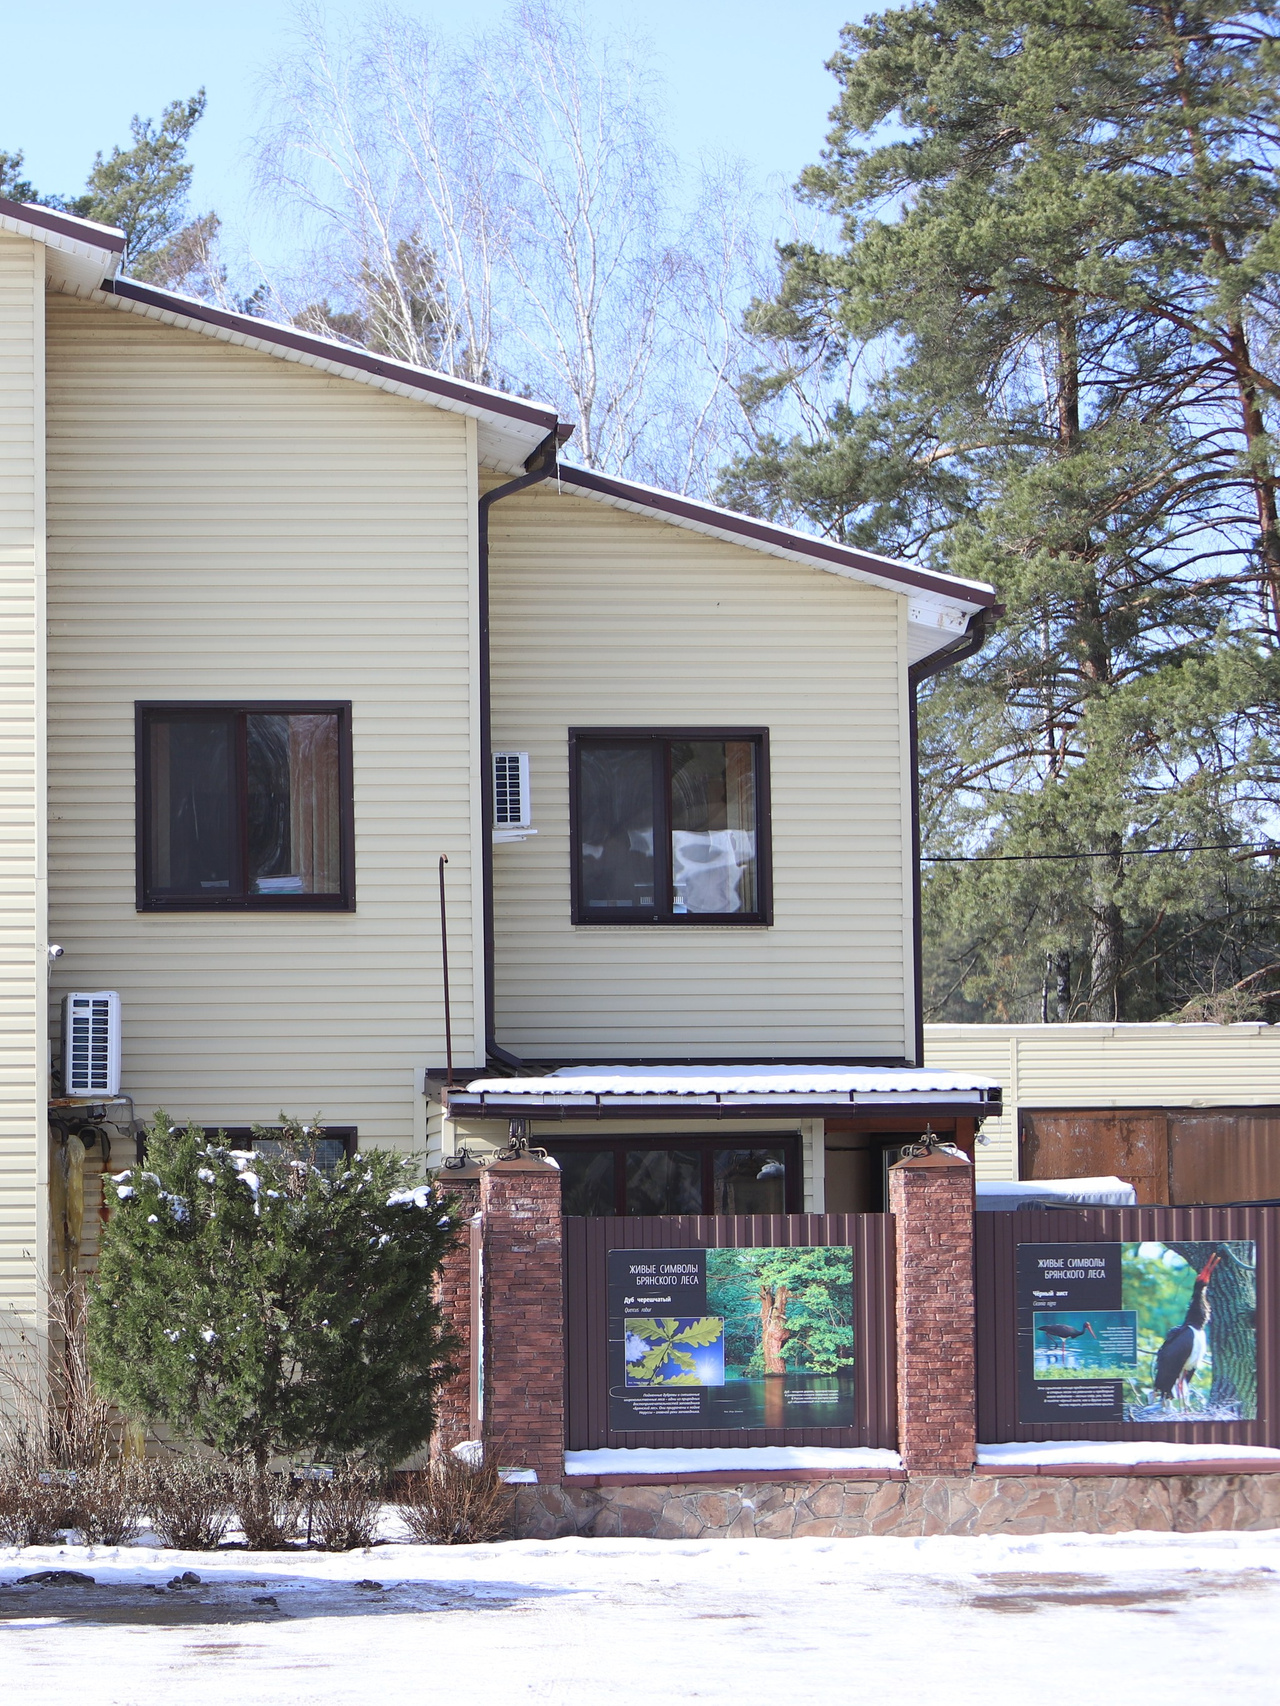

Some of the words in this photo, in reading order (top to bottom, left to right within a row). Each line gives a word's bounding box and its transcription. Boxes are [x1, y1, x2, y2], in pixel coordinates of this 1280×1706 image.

[1038, 1259, 1064, 1267] ЖИВЫЕ
[1068, 1258, 1105, 1267] СИМВОЛЫ
[630, 1265, 656, 1274] ЖИВЫЕ
[660, 1264, 698, 1273] СИМВОЛЫ
[1045, 1270, 1084, 1279] БРЯНСКОГО
[1088, 1270, 1106, 1278] ЛЕСА
[637, 1276, 677, 1285] БРЯНСКОГО
[681, 1275, 699, 1284] ЛЕСА
